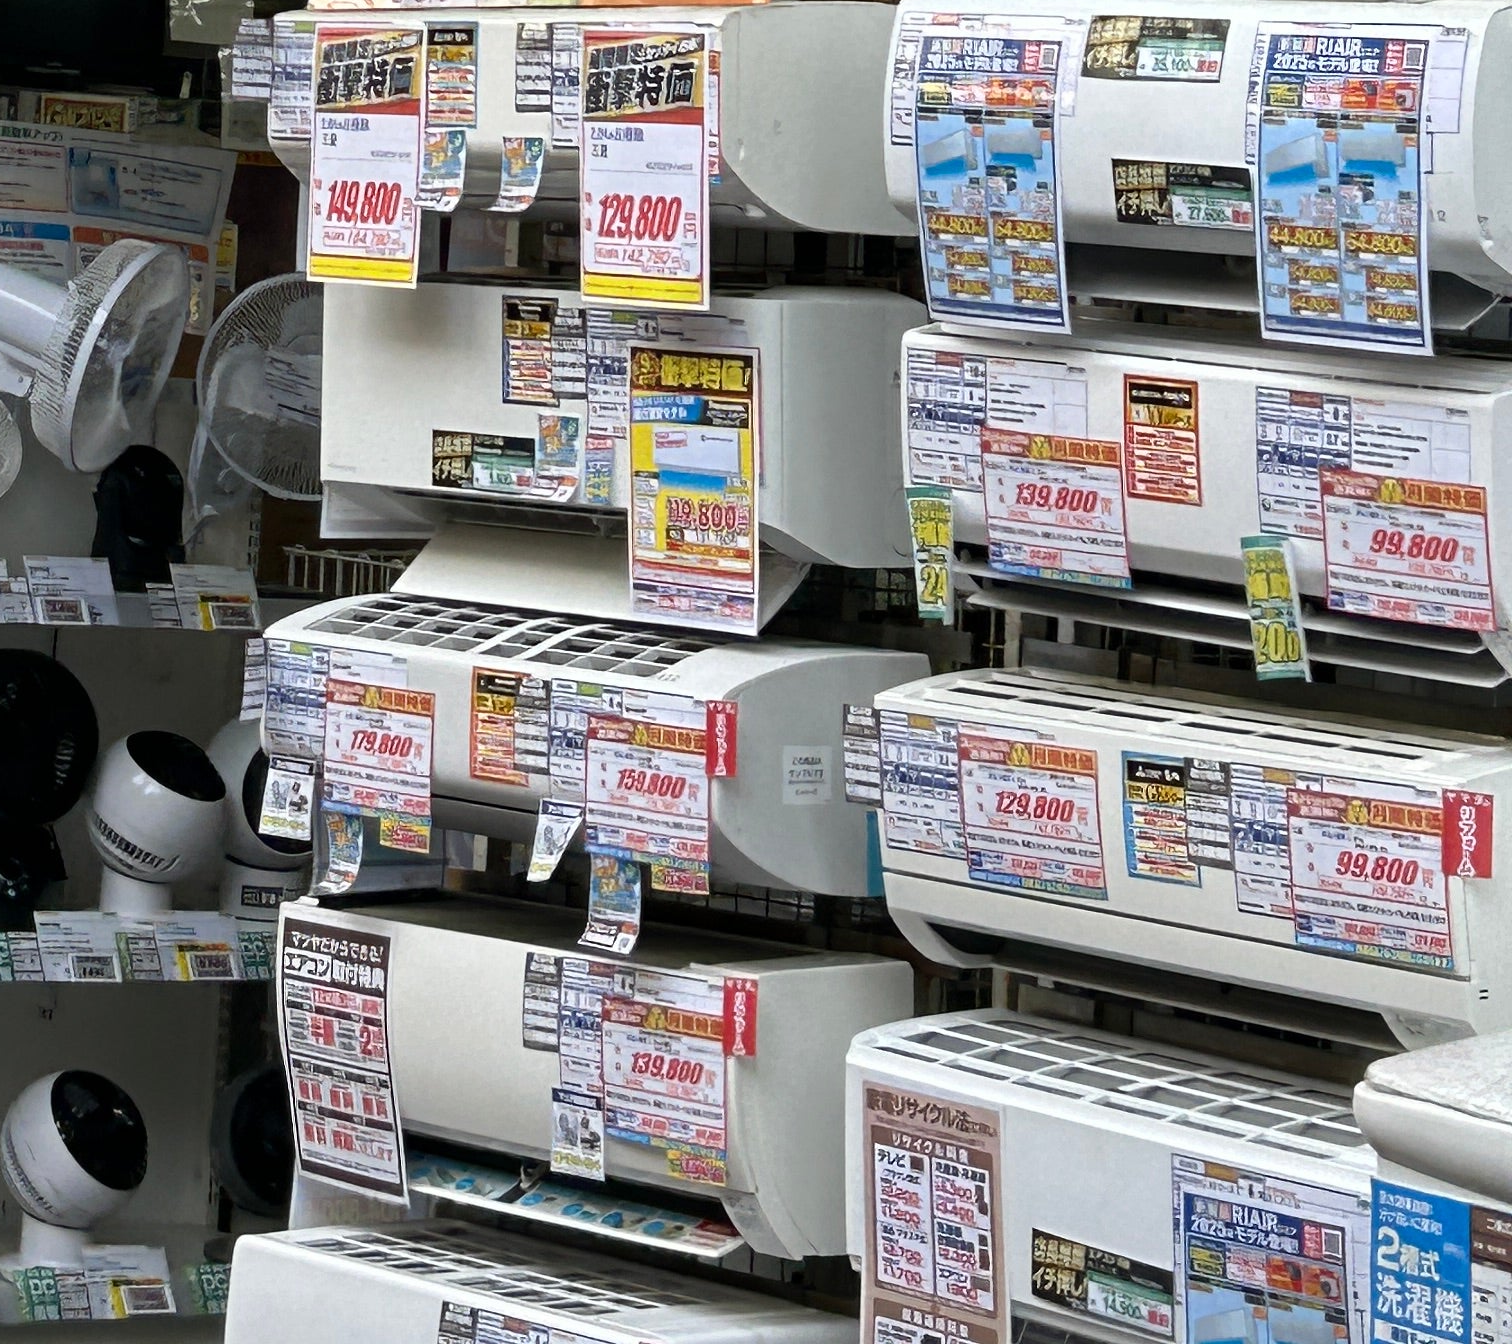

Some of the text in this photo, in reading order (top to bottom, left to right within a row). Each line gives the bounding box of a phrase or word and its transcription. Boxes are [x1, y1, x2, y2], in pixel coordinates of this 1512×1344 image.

[326, 180, 402, 226] 149,800
[598, 193, 683, 243] 129,800
[1016, 483, 1098, 513] 139,800
[1370, 528, 1459, 561] 99,800
[351, 729, 412, 758] 179,800
[996, 790, 1076, 824] 129,800
[1336, 850, 1419, 886] 99,800
[631, 1051, 704, 1085] 139,800
[1376, 1272, 1465, 1337] 洗濯機
